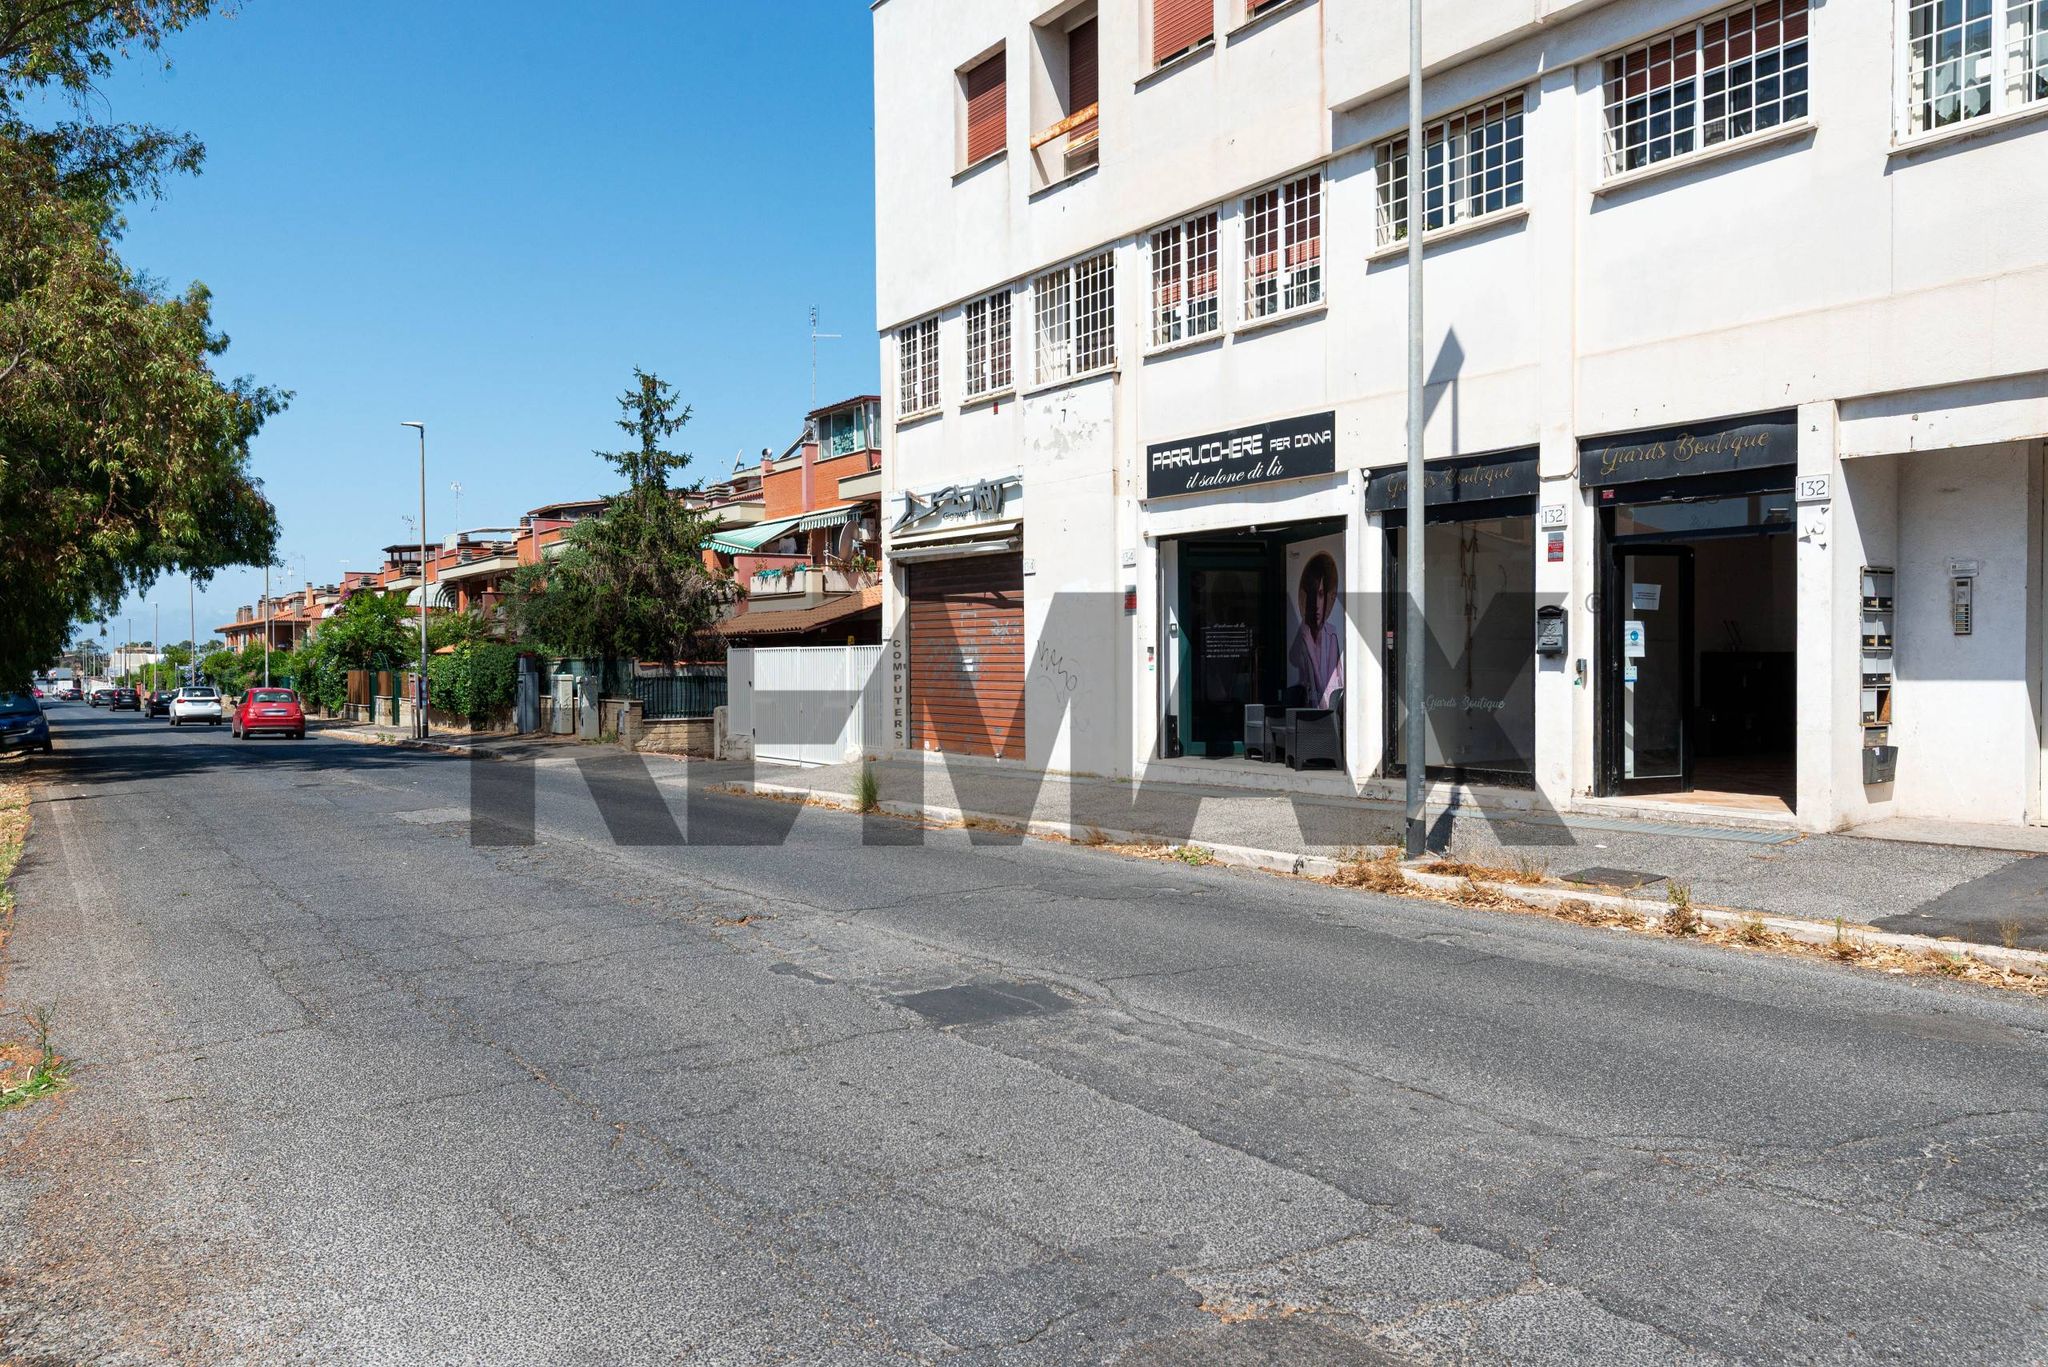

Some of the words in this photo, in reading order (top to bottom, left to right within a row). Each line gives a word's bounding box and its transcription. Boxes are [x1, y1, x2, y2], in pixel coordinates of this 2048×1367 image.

[1269, 436, 1291, 452] PER
[1294, 430, 1332, 447] DONNA
[1673, 431, 1770, 463] Boutique
[1185, 471, 1199, 489] il
[1199, 468, 1245, 486] salone
[1246, 461, 1263, 479] di
[1801, 479, 1826, 497] 132
[1544, 508, 1564, 524] 132
[893, 639, 903, 739] COMPUTERS
